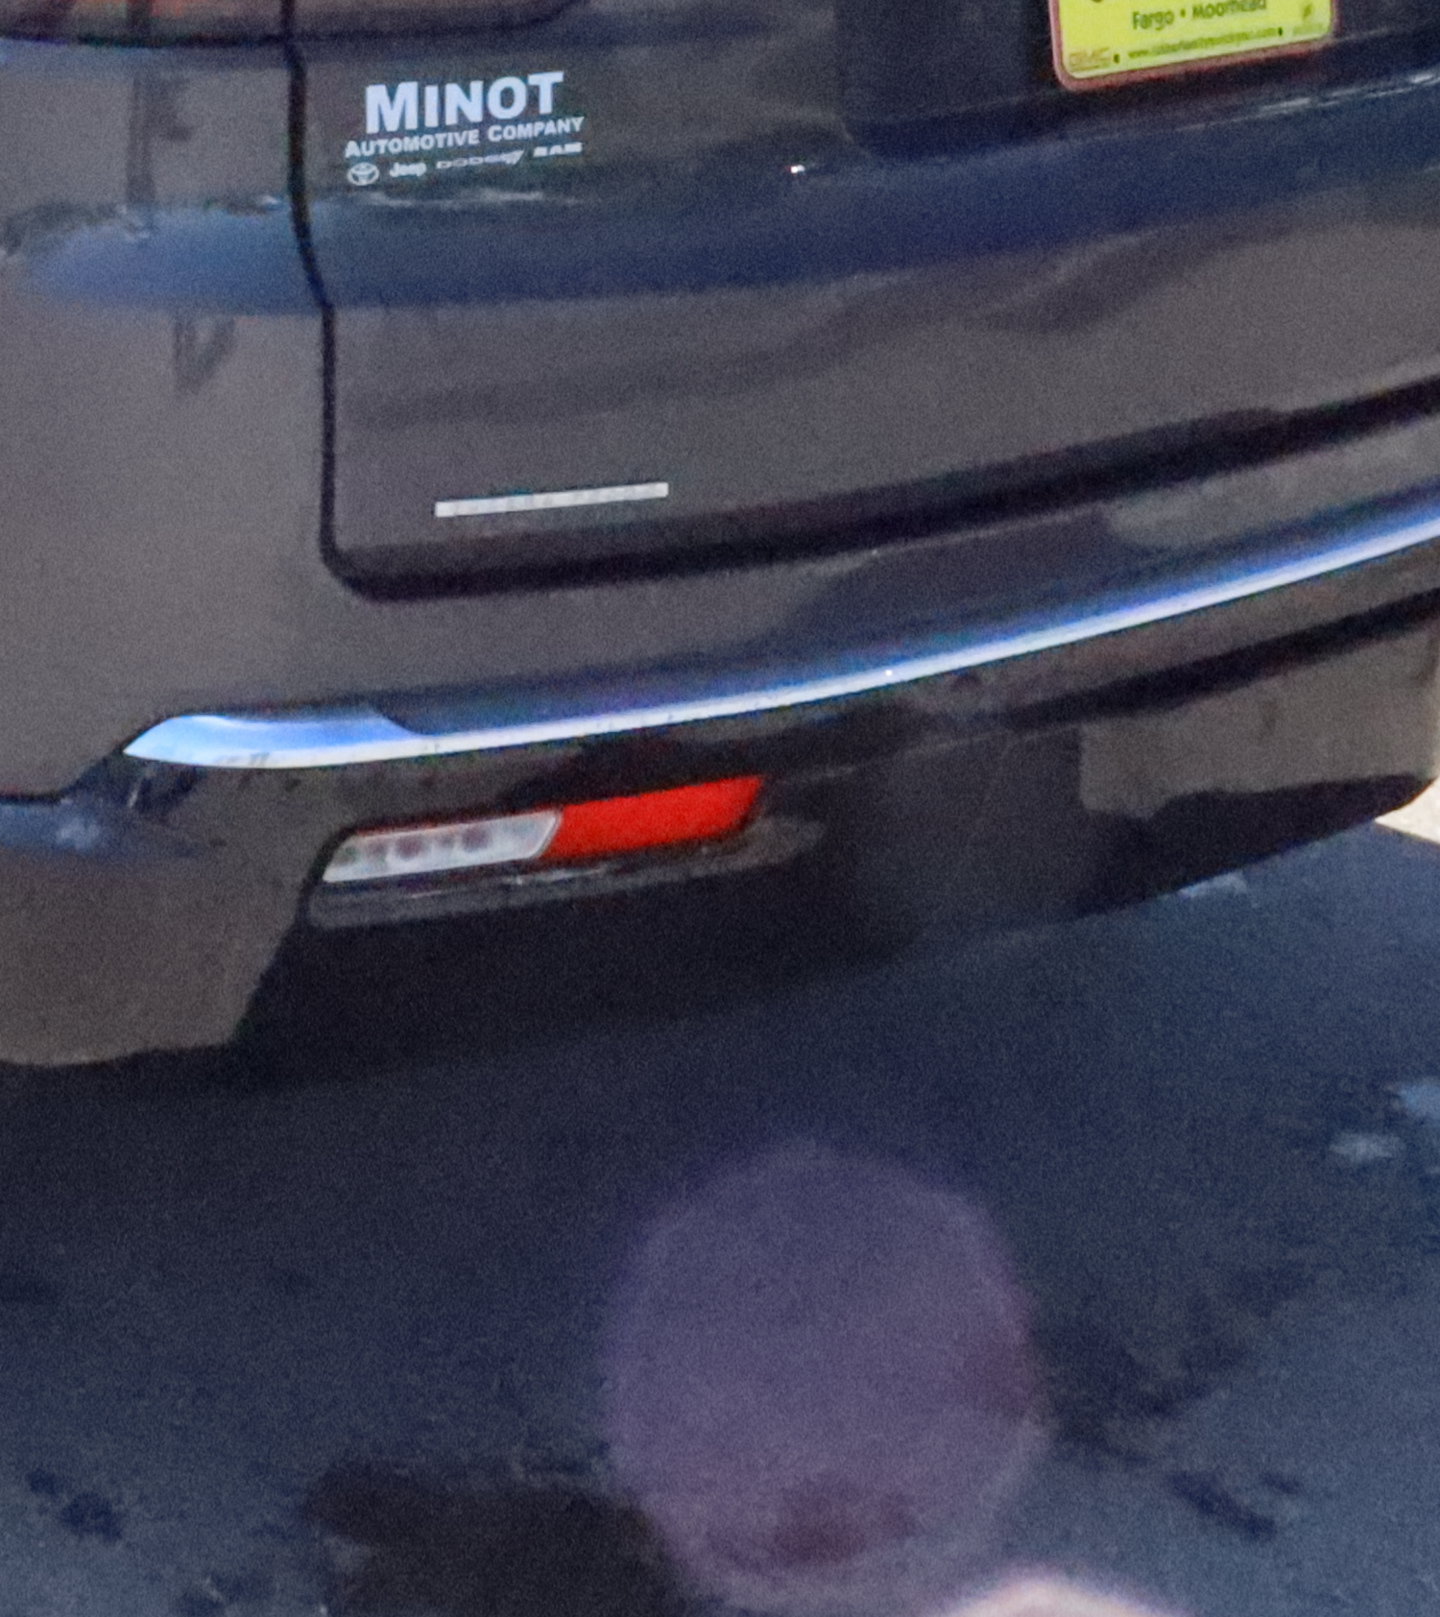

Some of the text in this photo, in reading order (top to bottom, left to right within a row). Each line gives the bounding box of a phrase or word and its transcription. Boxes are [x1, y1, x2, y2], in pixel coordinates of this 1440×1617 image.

[1131, 8, 1176, 31] Fargo
[365, 70, 565, 134] MINOT
[344, 116, 586, 159] AUTOMOTIVE COMPANY
